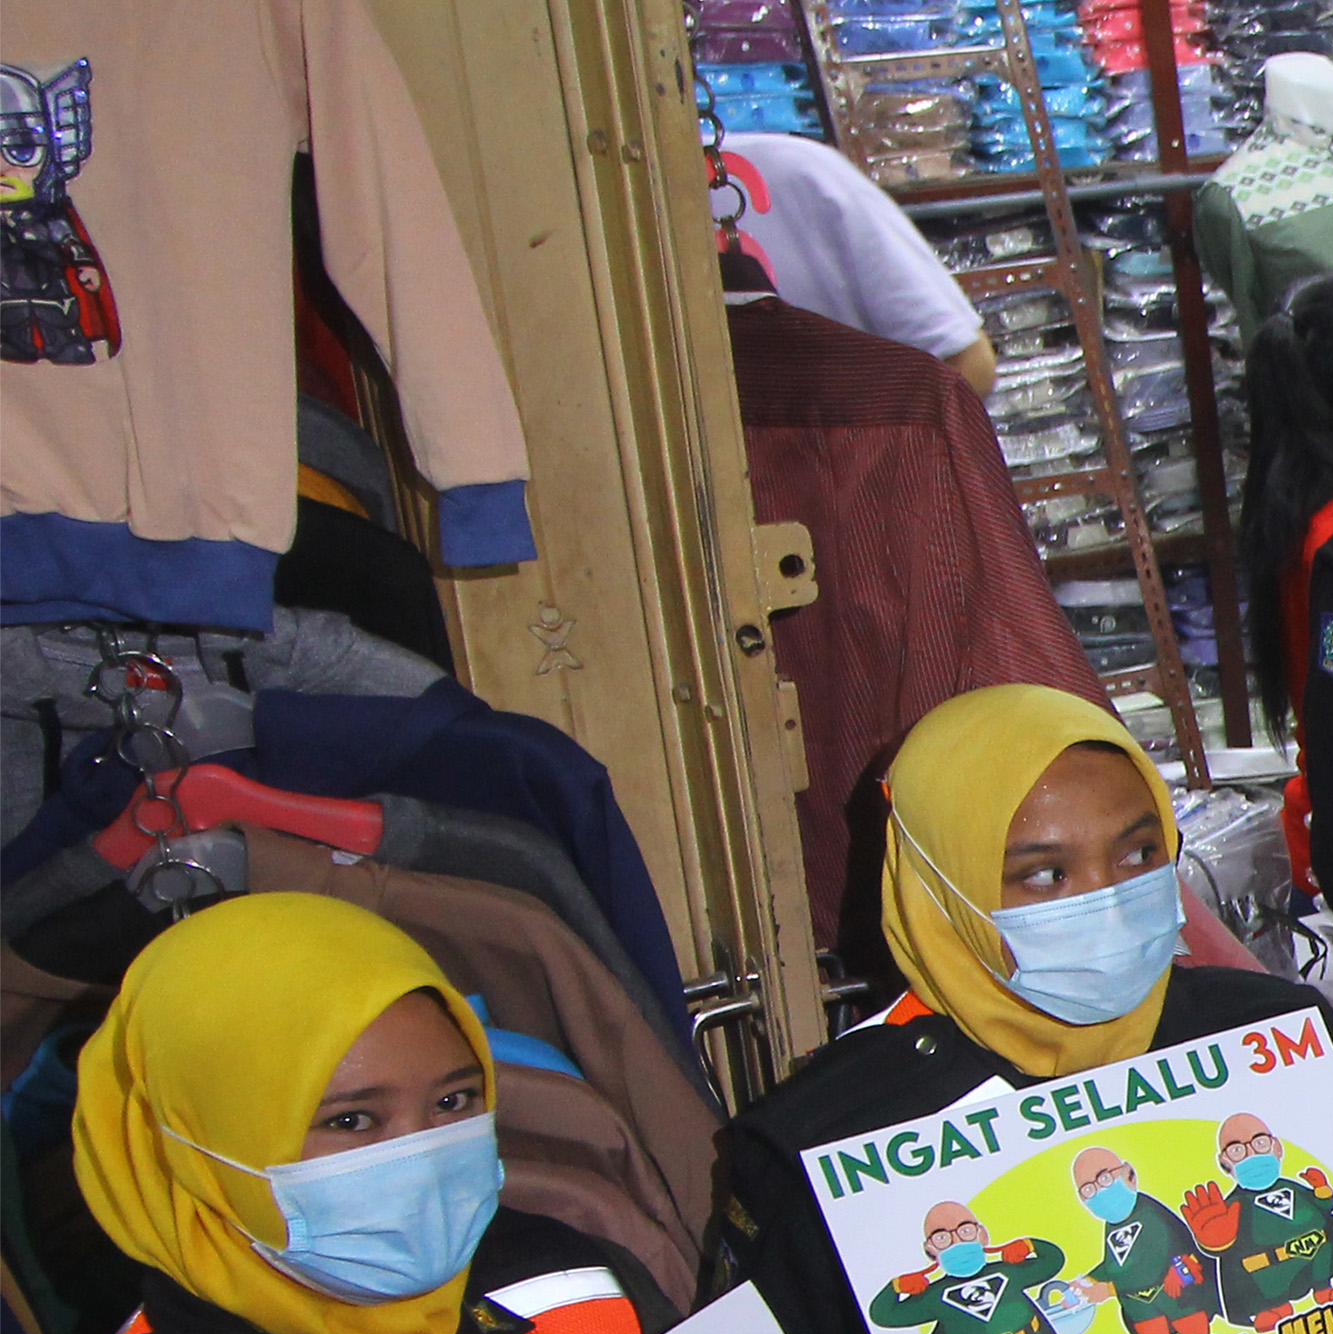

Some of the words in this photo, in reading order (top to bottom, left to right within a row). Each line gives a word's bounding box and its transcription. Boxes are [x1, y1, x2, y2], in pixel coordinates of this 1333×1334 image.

[818, 1108, 1000, 1199] INGAT
[1019, 1043, 1229, 1140] SELALU
[1241, 1017, 1325, 1074] 3M
